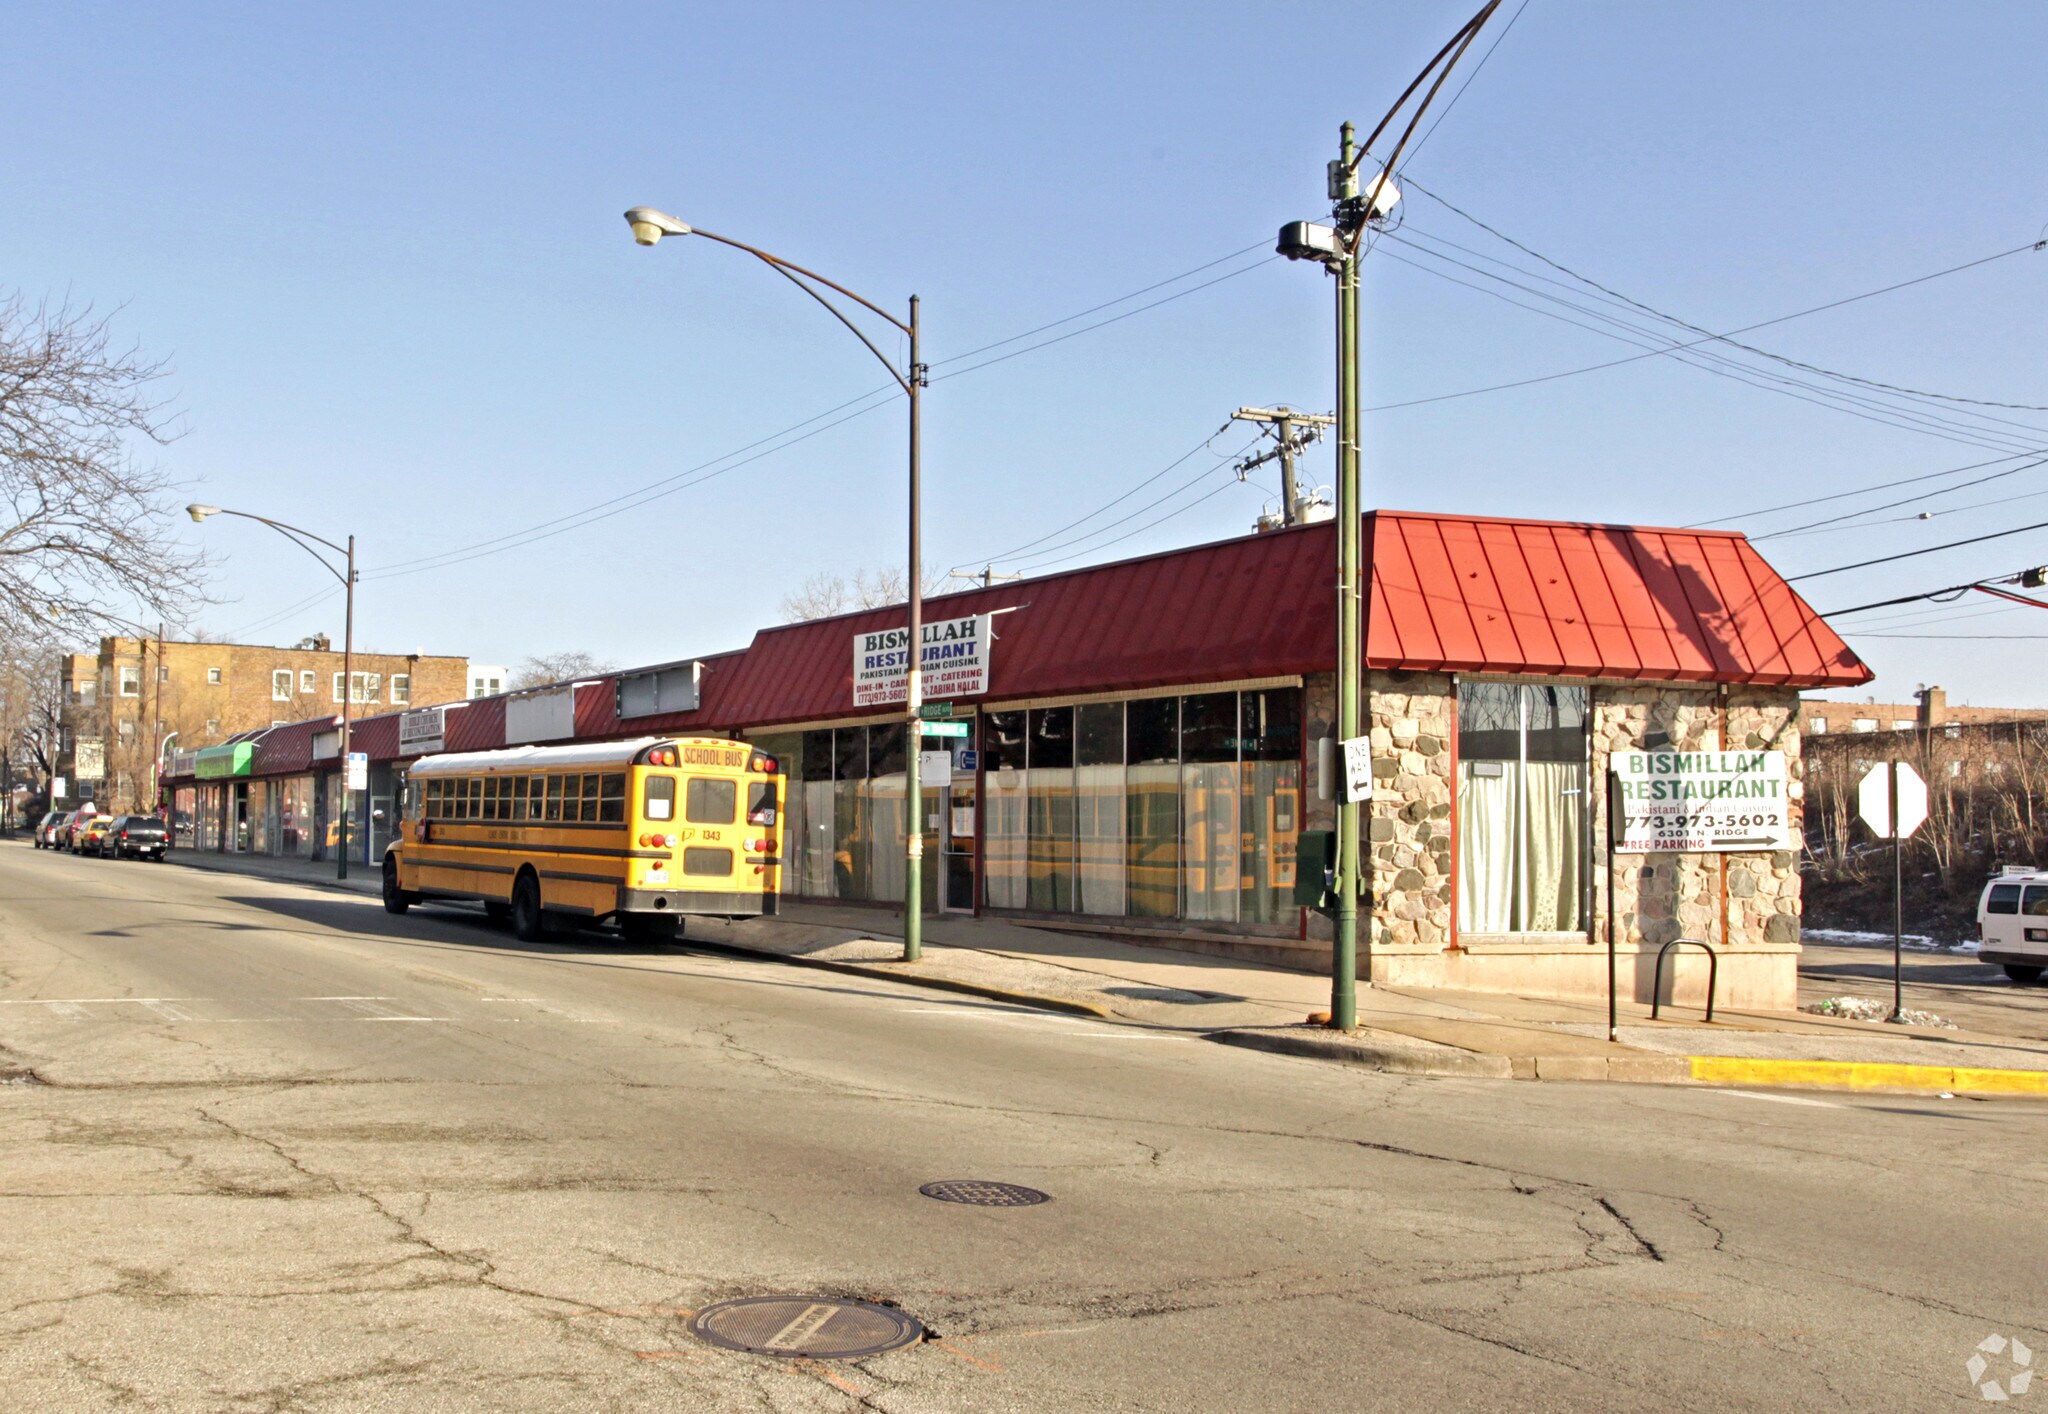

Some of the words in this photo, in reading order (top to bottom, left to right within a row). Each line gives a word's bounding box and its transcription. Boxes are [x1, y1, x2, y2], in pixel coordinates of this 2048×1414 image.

[864, 620, 977, 652] BISMLLAH
[865, 641, 978, 669] RESTURANT
[860, 668, 902, 679] PAKISTANI
[920, 662, 941, 671] DIAN
[942, 657, 979, 668] CUISINE
[856, 682, 883, 693] DINE-IN
[890, 678, 909, 688] CAR
[941, 669, 983, 681] CATERING
[929, 683, 954, 696] ZABIHA
[955, 680, 980, 692] HALAL
[924, 704, 941, 716] RIDGE
[684, 748, 721, 765] SCHOOL
[725, 751, 743, 767] BUS
[1629, 754, 1765, 774] BISMILLAH
[1622, 779, 1780, 800] RESTAURANT
[1684, 804, 1690, 814] &
[1626, 814, 1779, 829] 773-973-5602
[703, 830, 721, 841] 1343
[1658, 829, 1690, 838] 6301
[1624, 840, 1650, 850] FREE
[1654, 839, 1705, 849] PARKING
